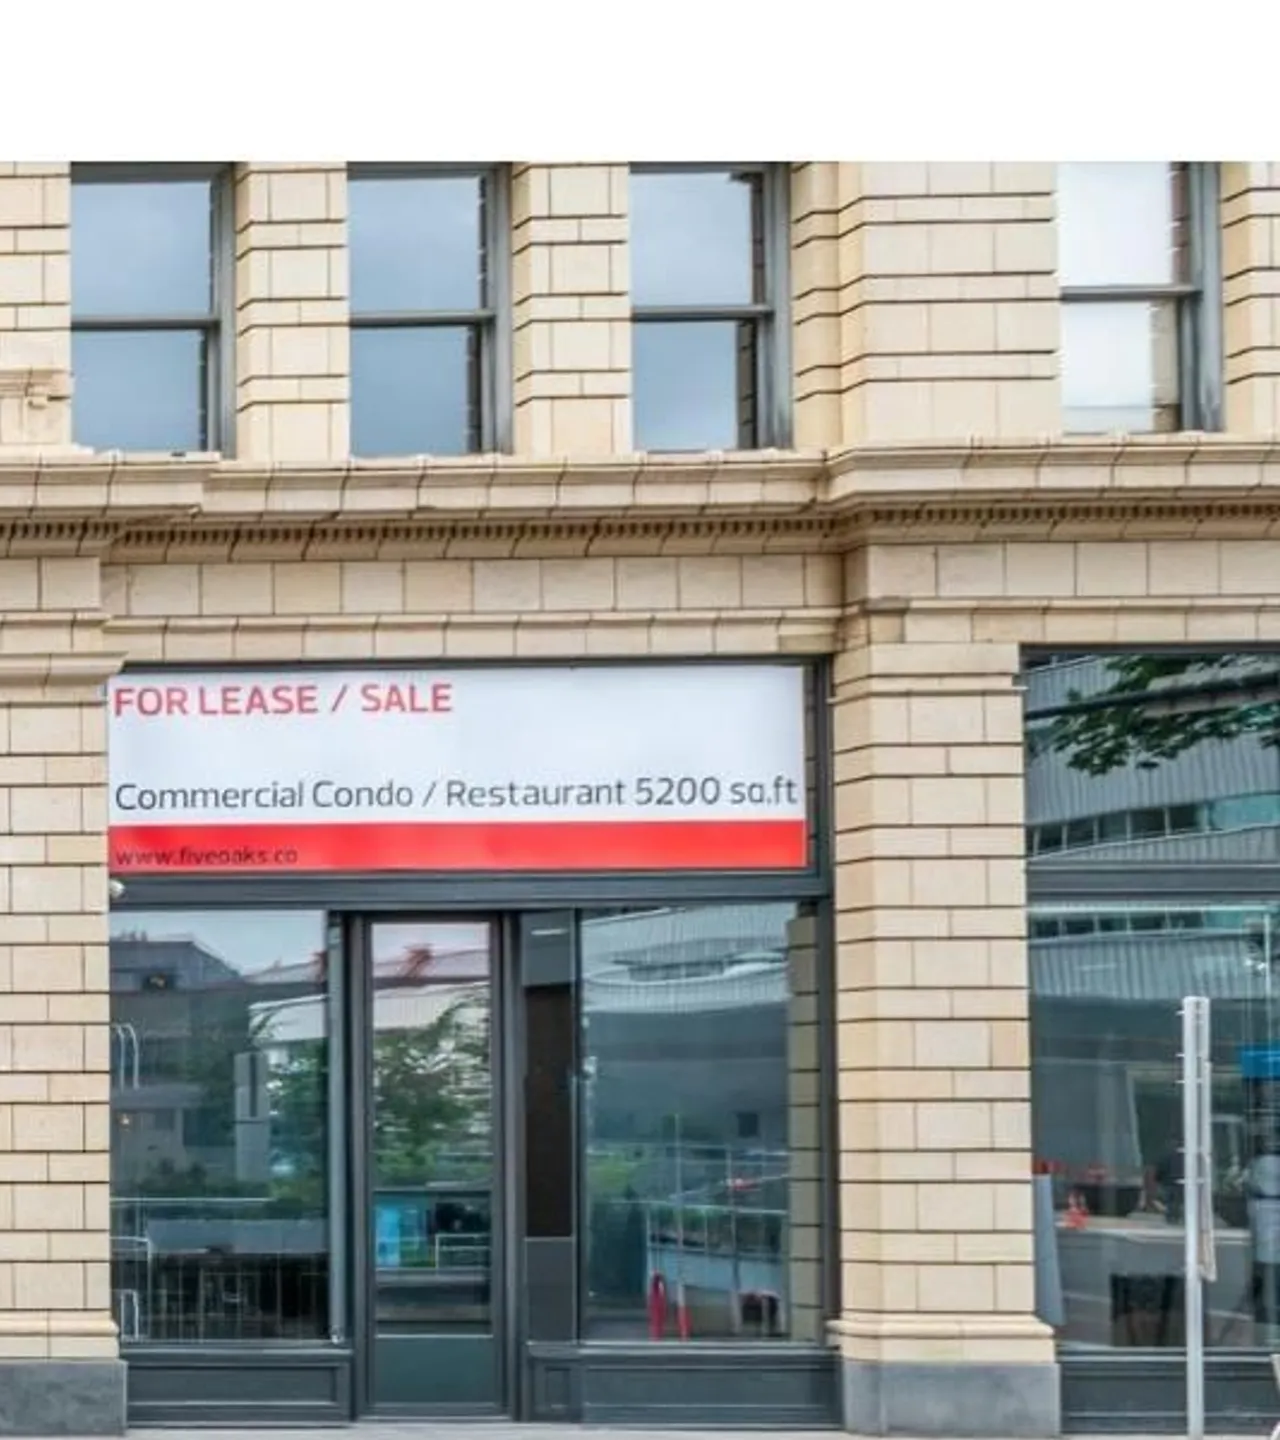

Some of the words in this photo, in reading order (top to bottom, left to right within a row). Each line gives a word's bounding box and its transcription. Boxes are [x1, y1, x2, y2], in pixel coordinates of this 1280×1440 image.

[114, 688, 188, 717] FOR
[198, 685, 318, 716] LEASE
[331, 684, 348, 713] /
[360, 683, 453, 713] SALE
[115, 782, 304, 810] Commercial
[311, 780, 413, 808] Condo
[421, 780, 437, 808] /
[446, 778, 626, 808] Restaurant
[635, 776, 721, 806] 5200
